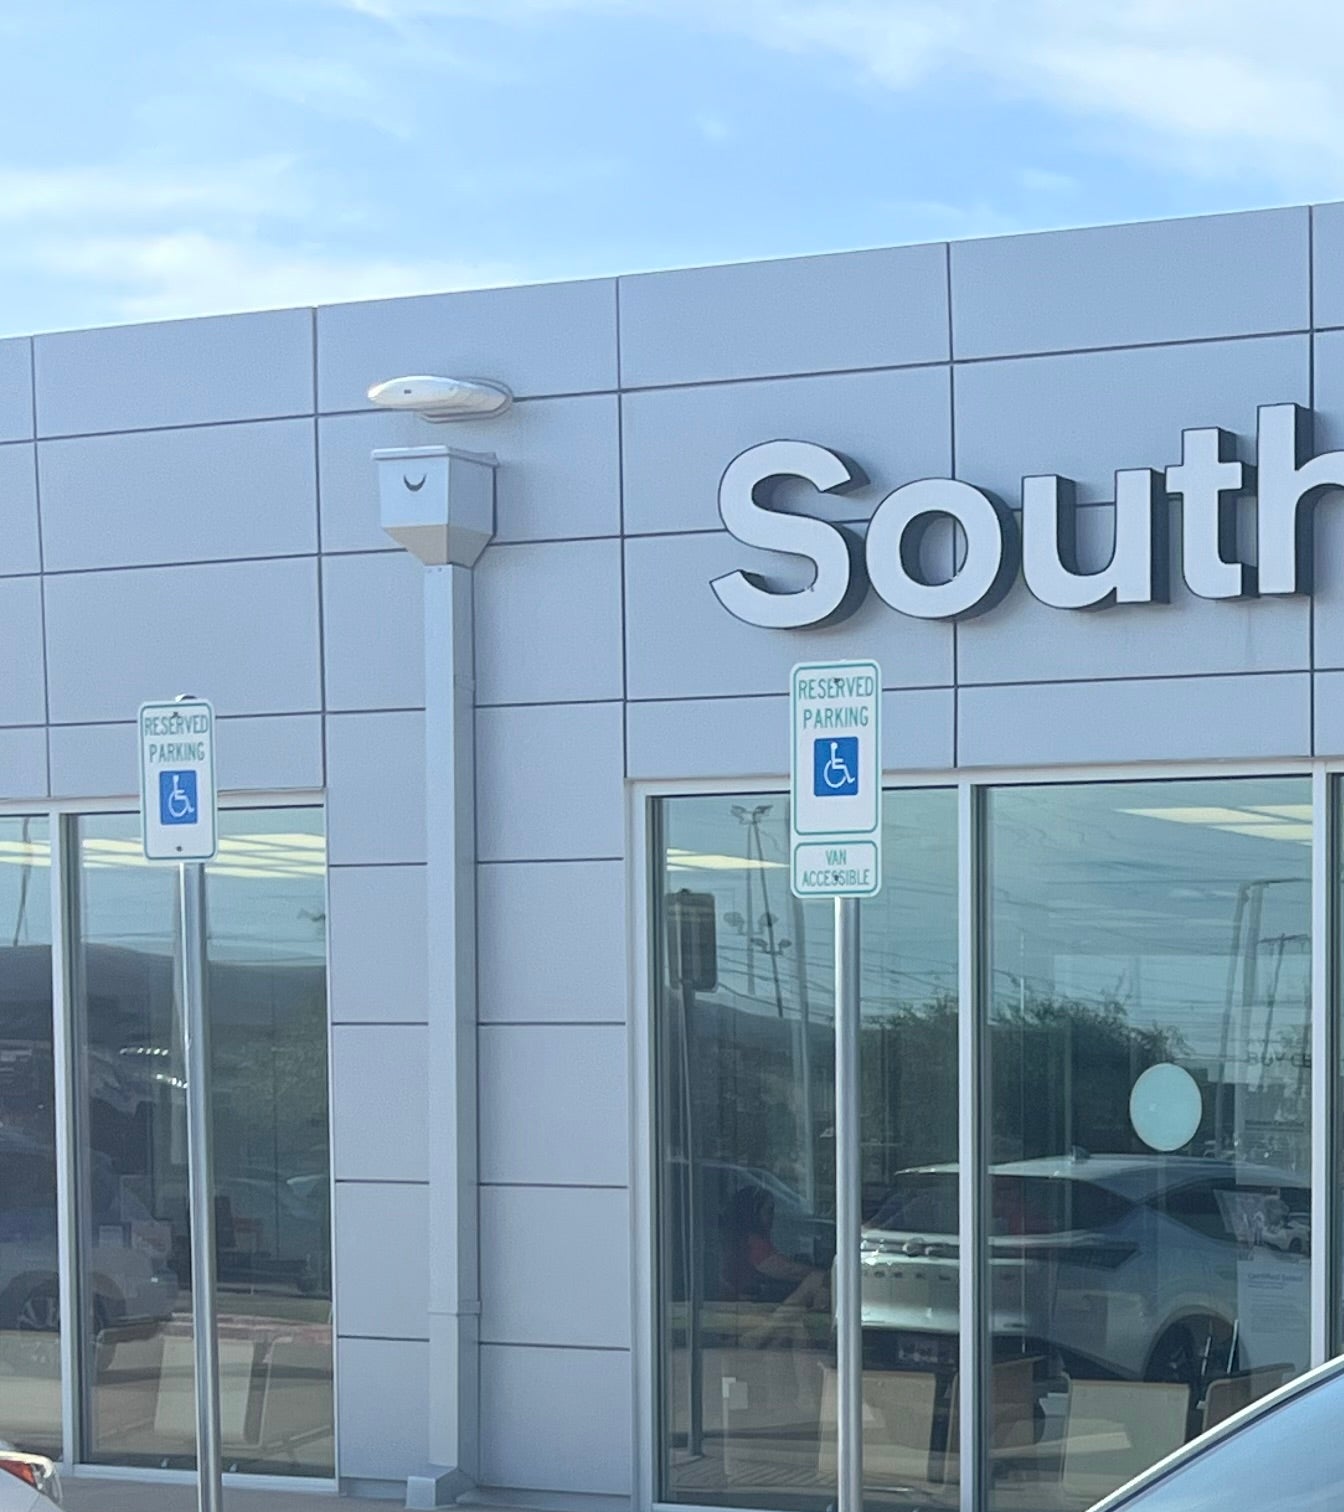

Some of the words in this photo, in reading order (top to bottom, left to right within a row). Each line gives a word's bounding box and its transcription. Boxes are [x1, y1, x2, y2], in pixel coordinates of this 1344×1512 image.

[799, 676, 875, 700] RESERVED
[144, 715, 209, 736] RESERVED
[803, 706, 869, 729] PARKING
[149, 742, 206, 763] PARKING
[825, 849, 847, 865] VAN
[802, 869, 870, 886] ACCESSIBLE
